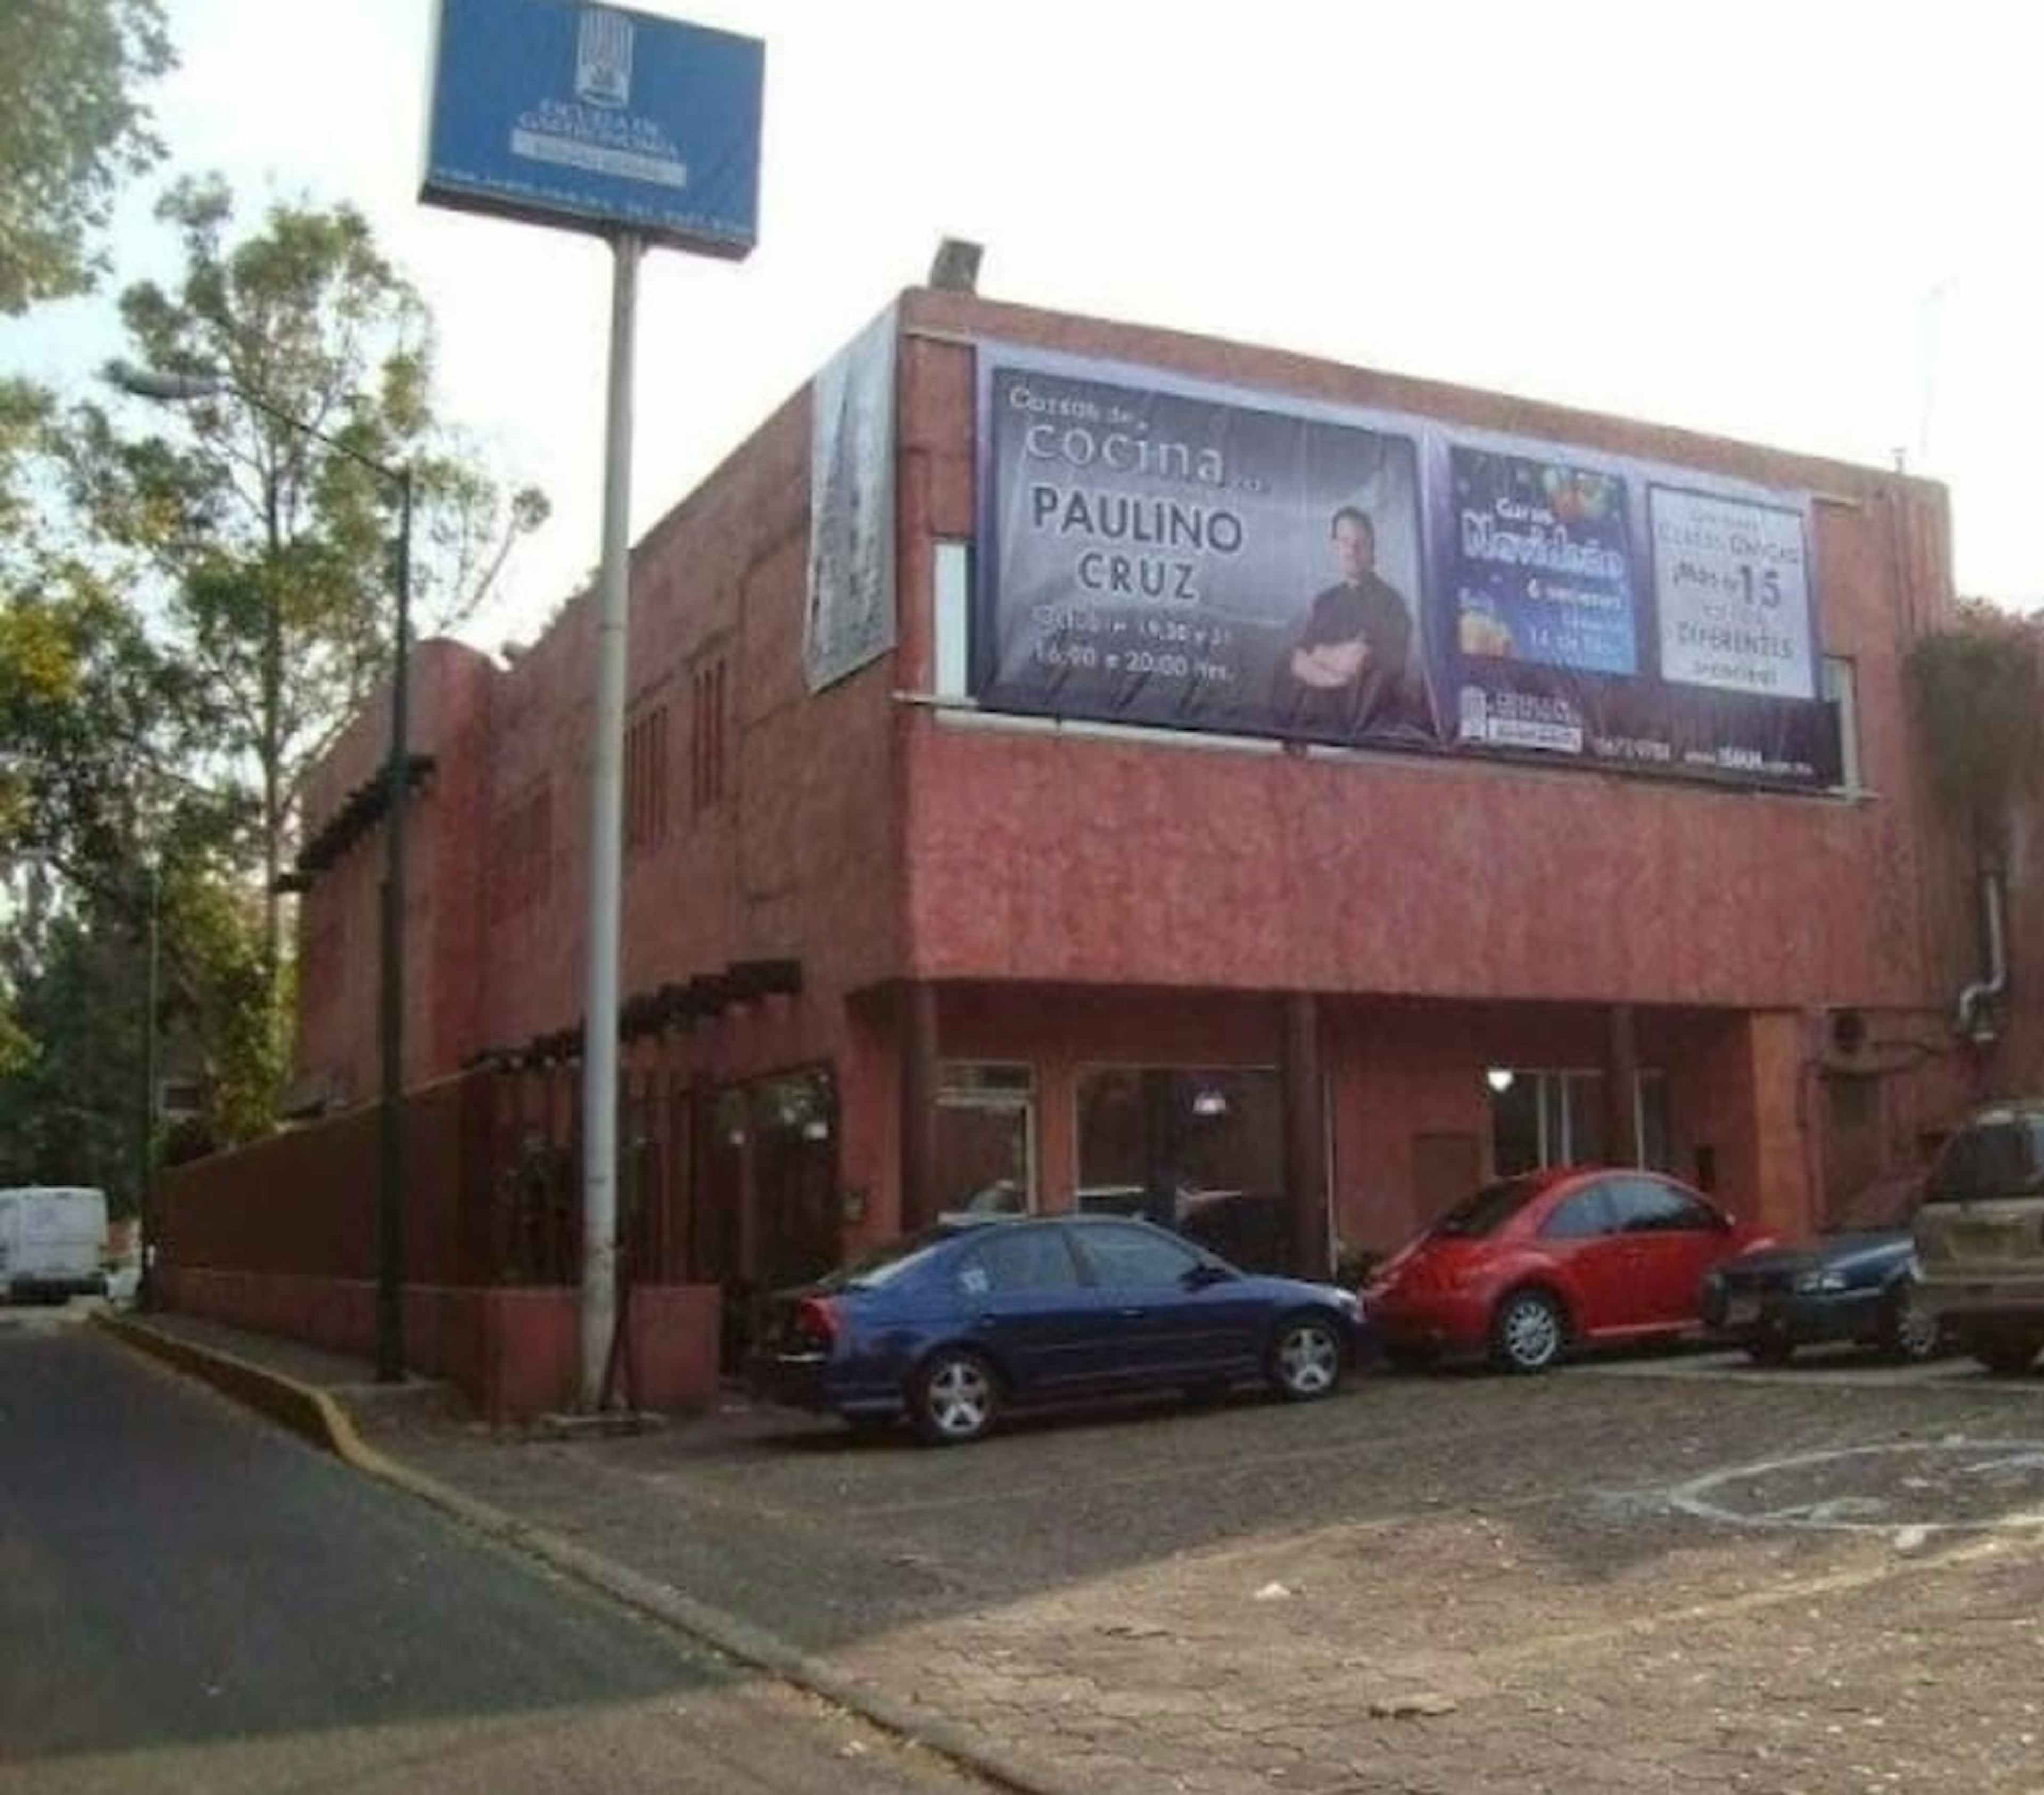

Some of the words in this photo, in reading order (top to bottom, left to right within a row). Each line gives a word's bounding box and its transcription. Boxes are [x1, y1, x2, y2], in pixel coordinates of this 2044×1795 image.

[1032, 485, 1243, 553] PAULINO
[1078, 551, 1196, 600] CRUZ
[1739, 564, 1782, 608] 15
